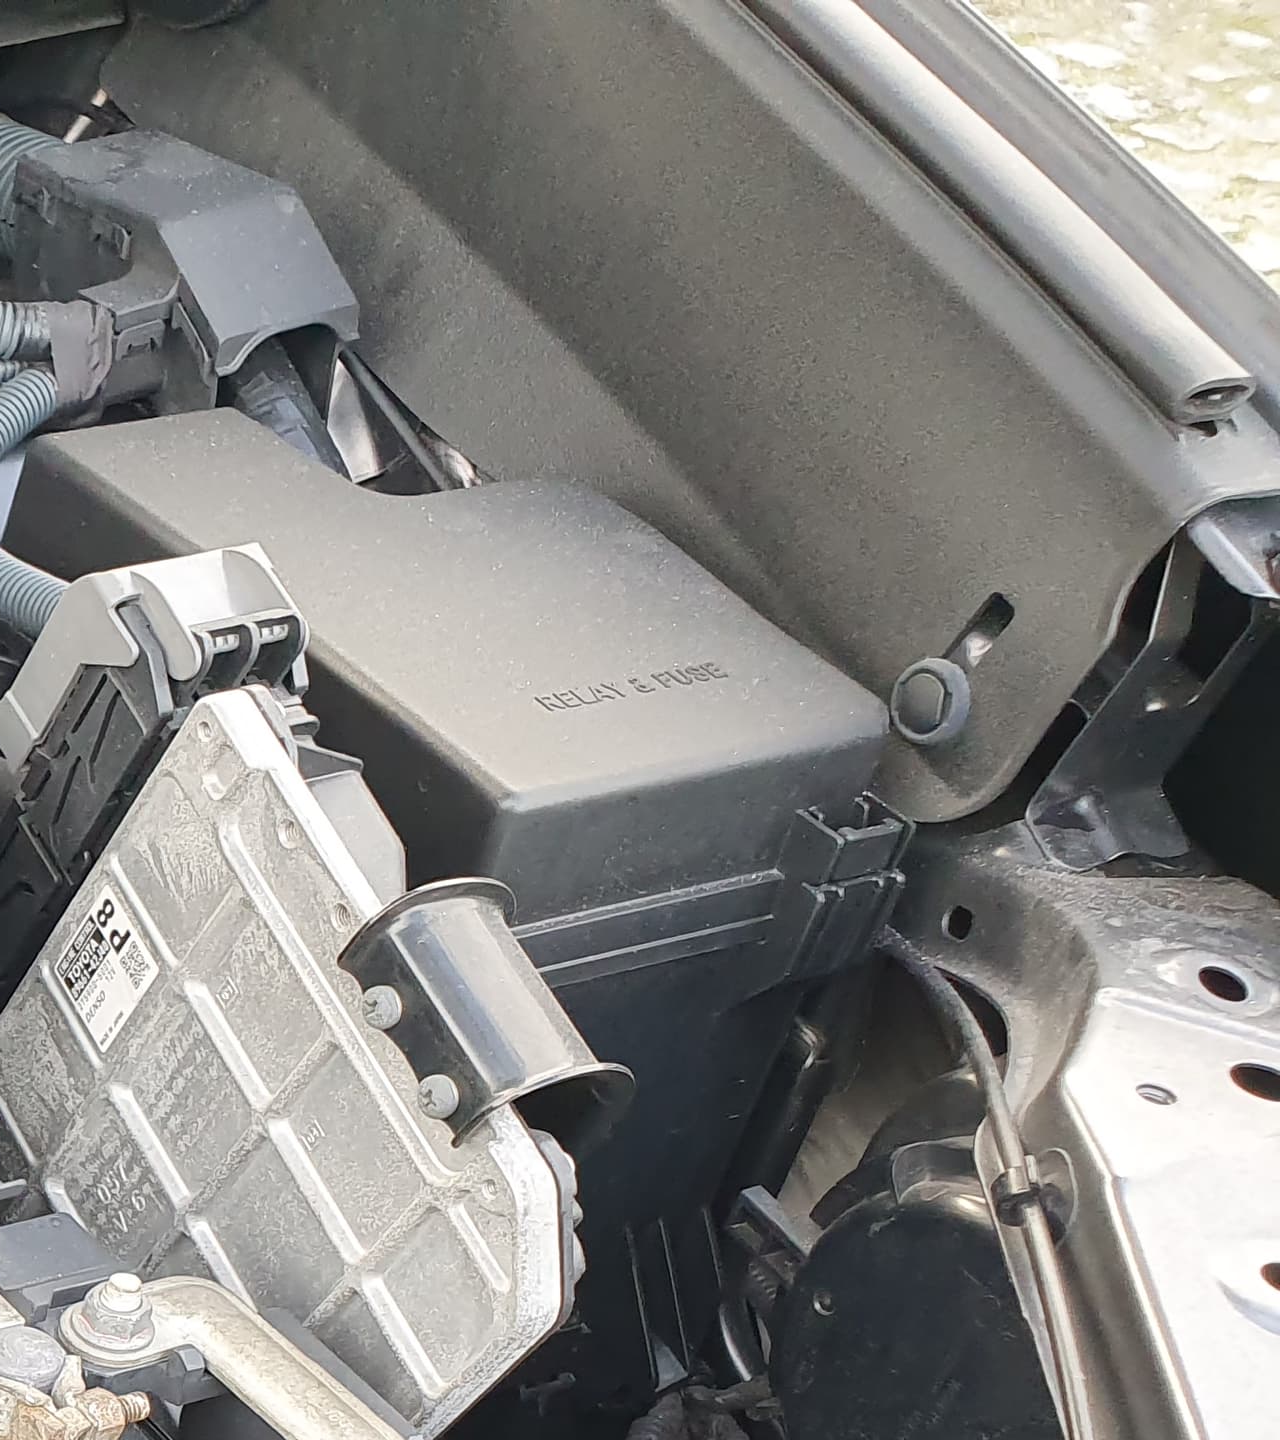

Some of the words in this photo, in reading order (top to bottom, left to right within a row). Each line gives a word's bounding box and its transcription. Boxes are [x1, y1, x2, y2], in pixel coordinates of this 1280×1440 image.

[534, 683, 626, 712] RELAY
[627, 677, 656, 694] &
[650, 661, 729, 689] FUSE
[68, 938, 99, 983] TOYOTA
[85, 990, 106, 1023] DENSO
